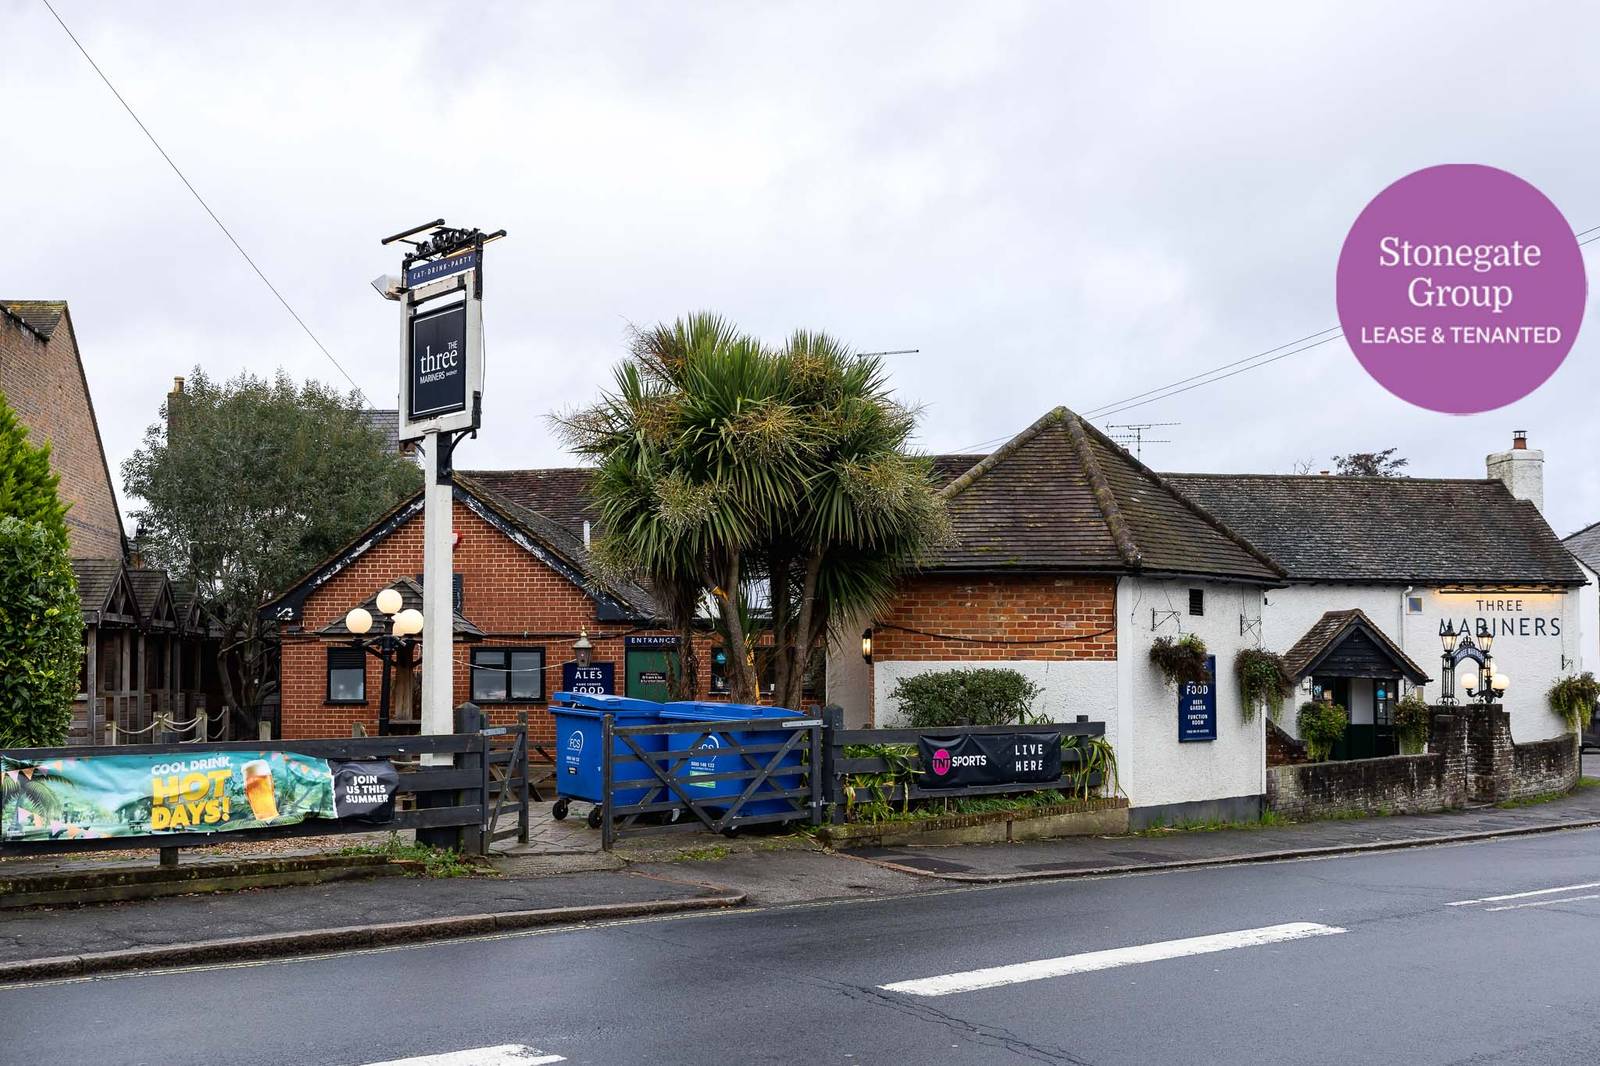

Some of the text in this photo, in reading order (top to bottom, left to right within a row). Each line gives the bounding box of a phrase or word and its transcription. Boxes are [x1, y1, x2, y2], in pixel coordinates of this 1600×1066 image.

[448, 340, 458, 350] THE
[420, 345, 458, 374] three
[419, 371, 446, 384] MARINERS
[1476, 599, 1523, 611] THREE
[575, 671, 603, 680] ALES
[573, 686, 605, 695] FOOD
[1186, 685, 1208, 695] FOOD
[1015, 744, 1044, 756] LIVE
[151, 761, 189, 775] COOL
[932, 755, 987, 769] TNT SPORTS
[1015, 760, 1043, 772] HERE
[152, 768, 232, 805] HOT
[353, 775, 378, 786] JOIN
[346, 785, 386, 794] US THIS
[345, 794, 389, 804] SUMMER
[151, 796, 231, 830] DAYS!
